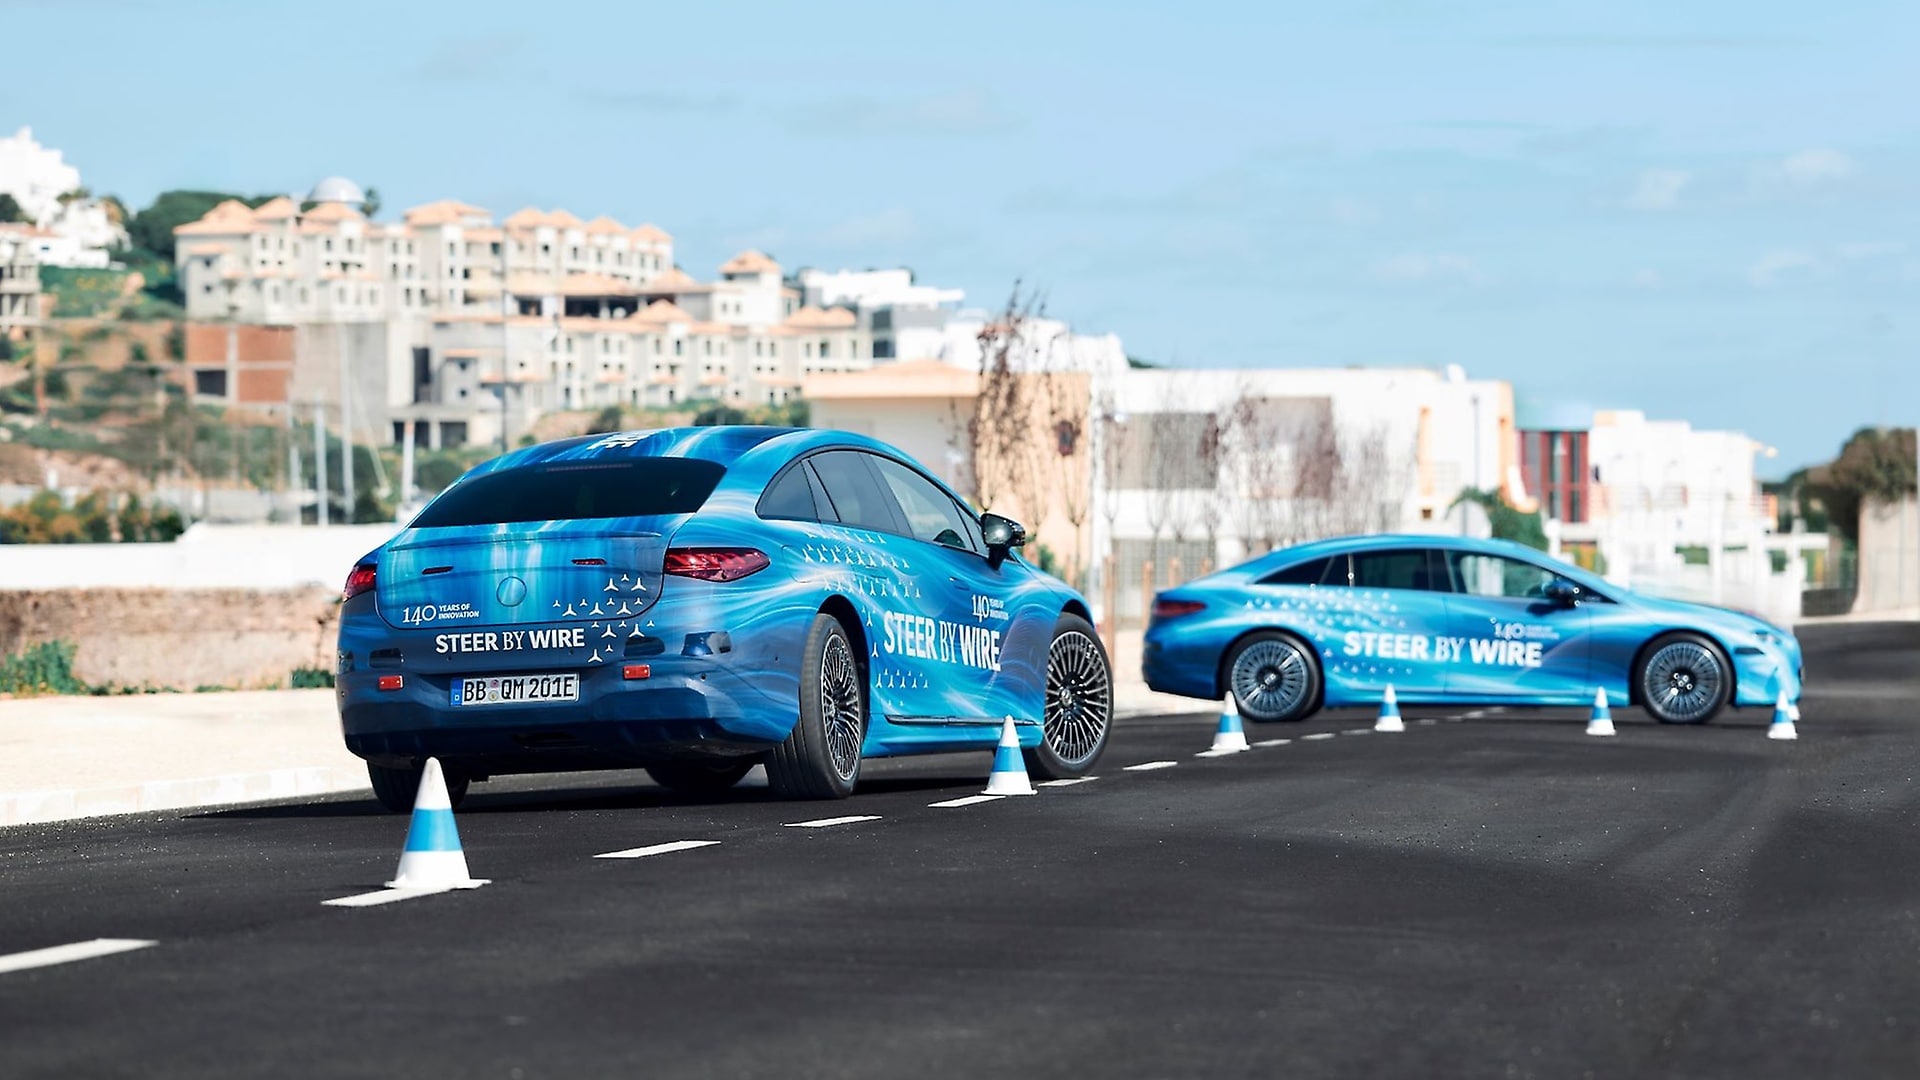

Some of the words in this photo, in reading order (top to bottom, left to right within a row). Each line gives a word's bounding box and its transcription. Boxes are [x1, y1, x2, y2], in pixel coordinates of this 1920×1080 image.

[402, 605, 437, 625] 140
[438, 611, 480, 620] INNOVATION
[439, 604, 460, 612] YEARS
[971, 594, 990, 623] 140
[436, 633, 498, 653] STEER
[502, 631, 525, 651] BY
[529, 628, 585, 648] WIRE
[883, 610, 938, 660] STEER
[938, 620, 958, 664] BY
[959, 624, 1001, 672] WIRE
[1343, 631, 1430, 661] STEER
[1434, 636, 1467, 663] BY
[1469, 638, 1544, 667] WIRE
[464, 681, 487, 701] BB
[501, 679, 525, 700] QM
[528, 676, 575, 698] 201E
